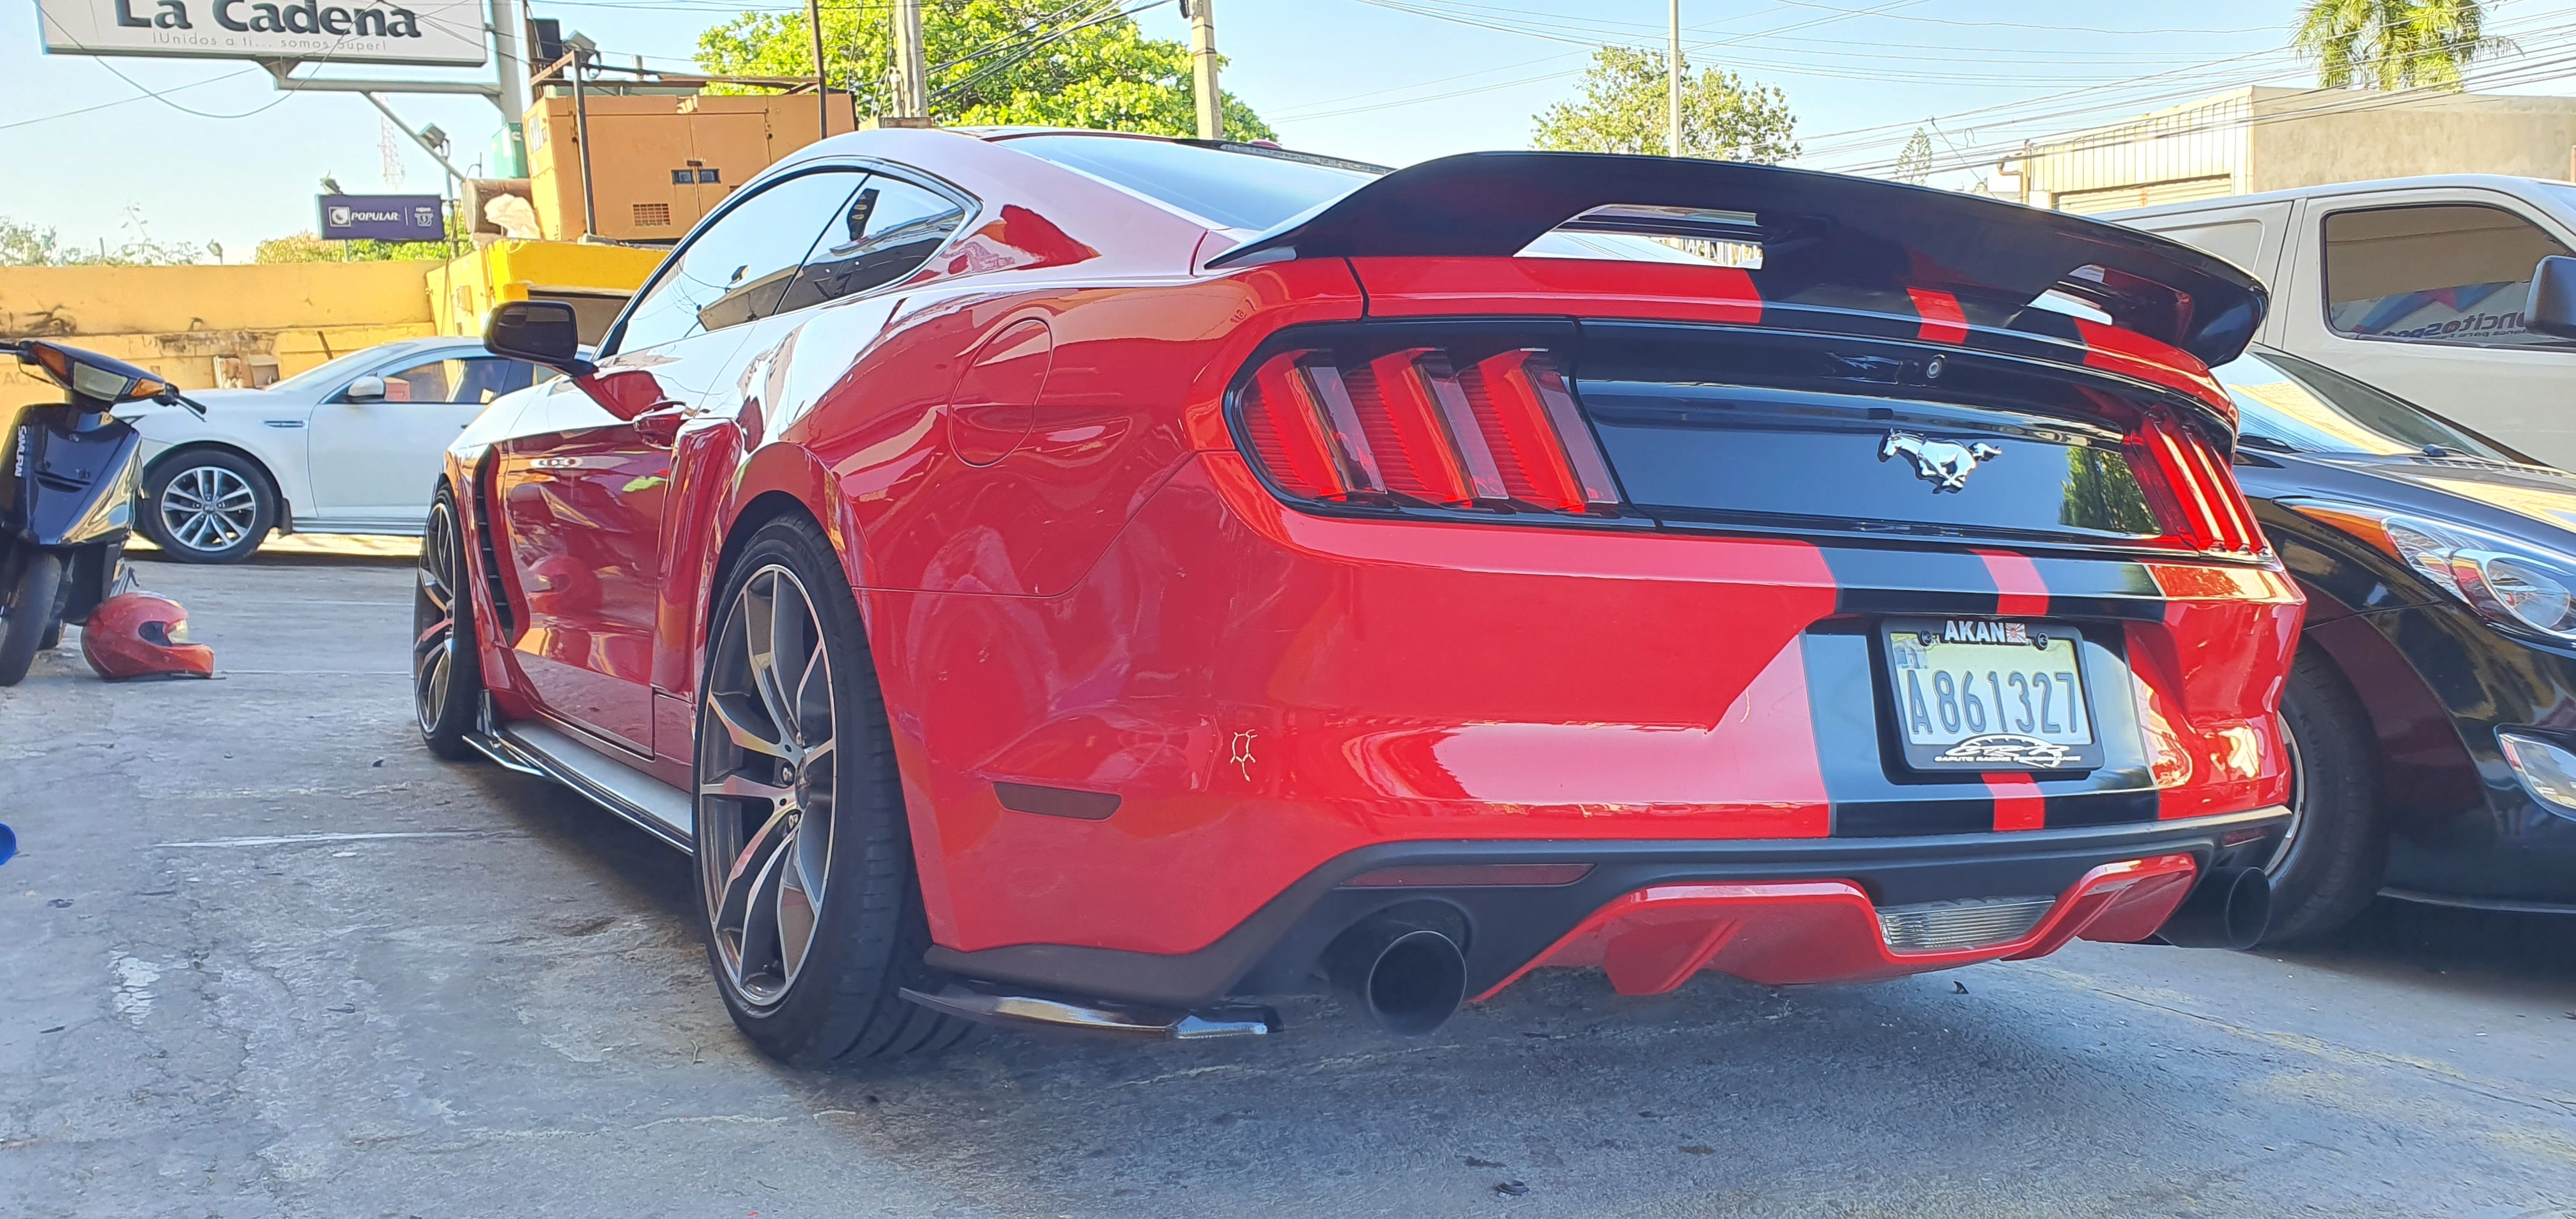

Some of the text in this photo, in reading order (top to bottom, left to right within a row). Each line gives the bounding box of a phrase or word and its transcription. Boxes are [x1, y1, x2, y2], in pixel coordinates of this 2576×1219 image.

[114, 0, 422, 38] La Cadena
[226, 37, 234, 46] a
[280, 39, 328, 49] somos
[351, 211, 399, 221] POPULAR
[14, 425, 27, 477] SAMURAI
[1944, 620, 2006, 643] AKAN
[1907, 669, 2077, 735] A861327
